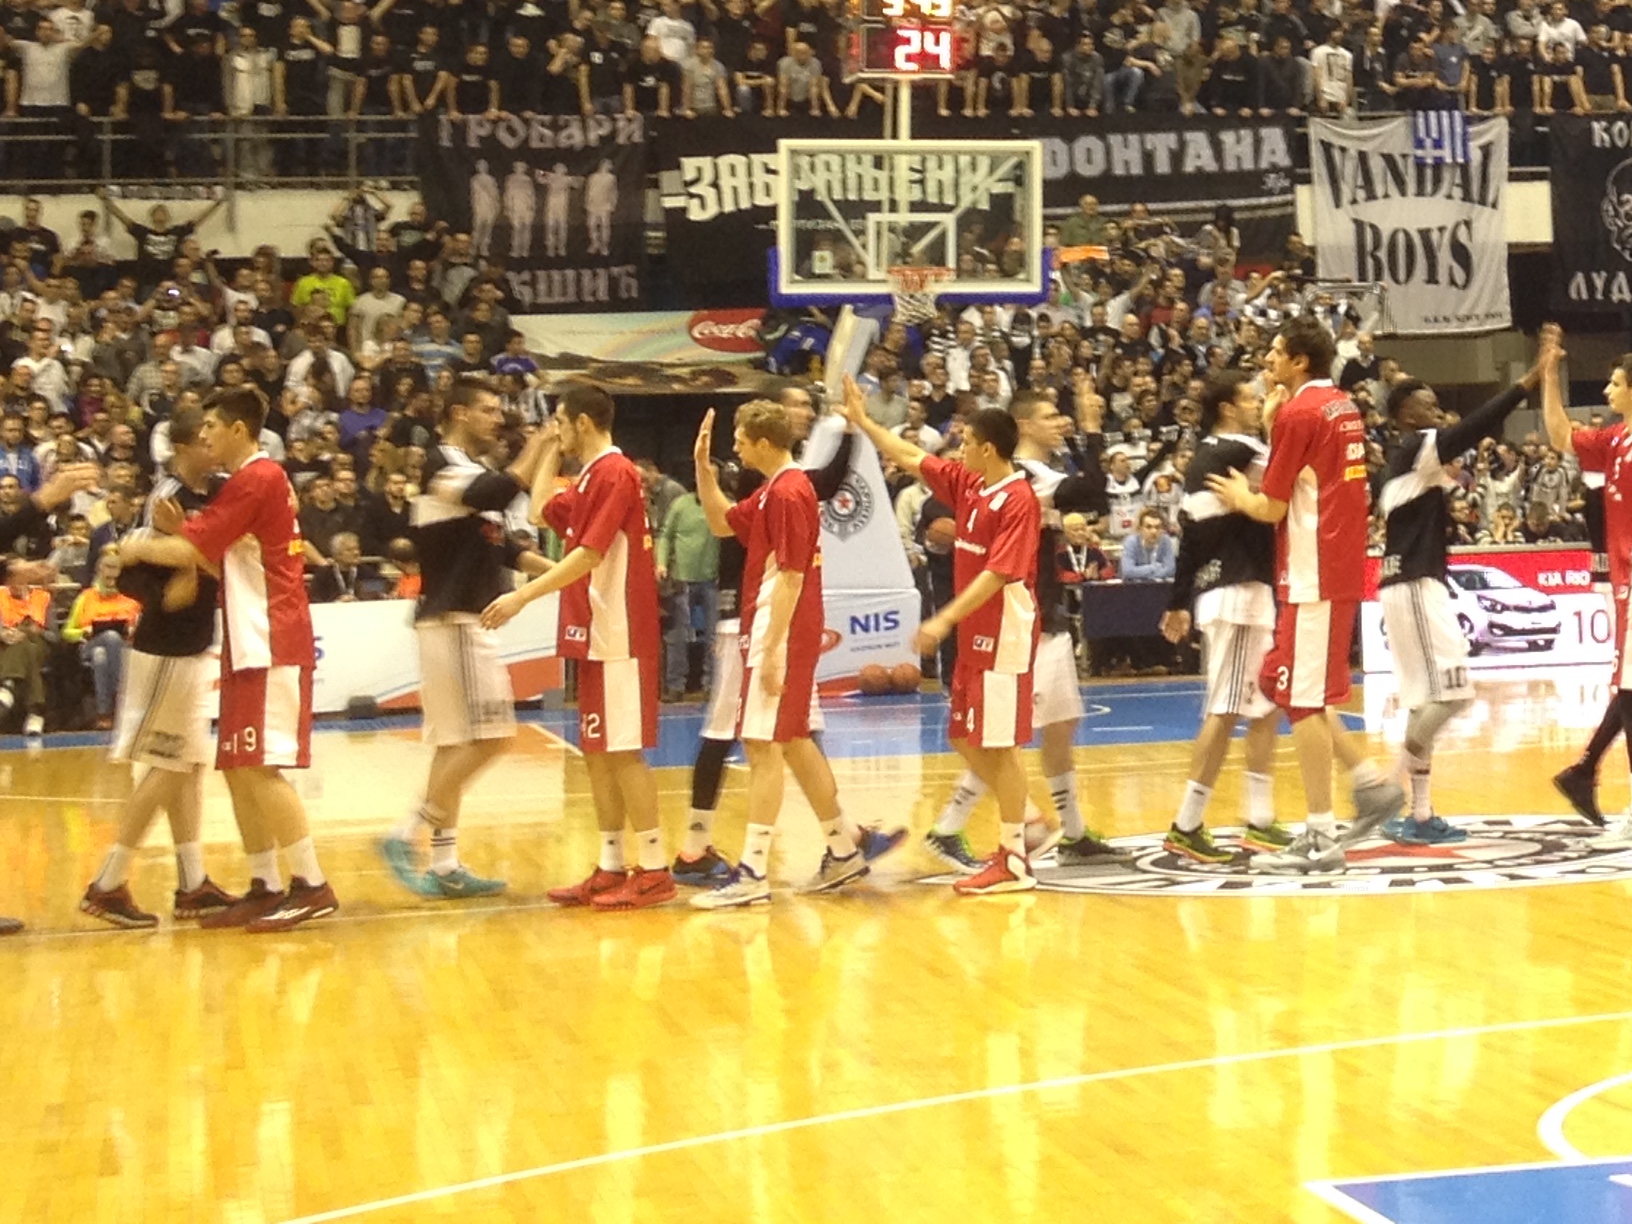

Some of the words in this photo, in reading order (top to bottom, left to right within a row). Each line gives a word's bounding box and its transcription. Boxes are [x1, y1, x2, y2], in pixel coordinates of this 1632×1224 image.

[895, 29, 951, 71] 24
[1352, 217, 1477, 291] BOYS
[849, 610, 901, 635] NIS
